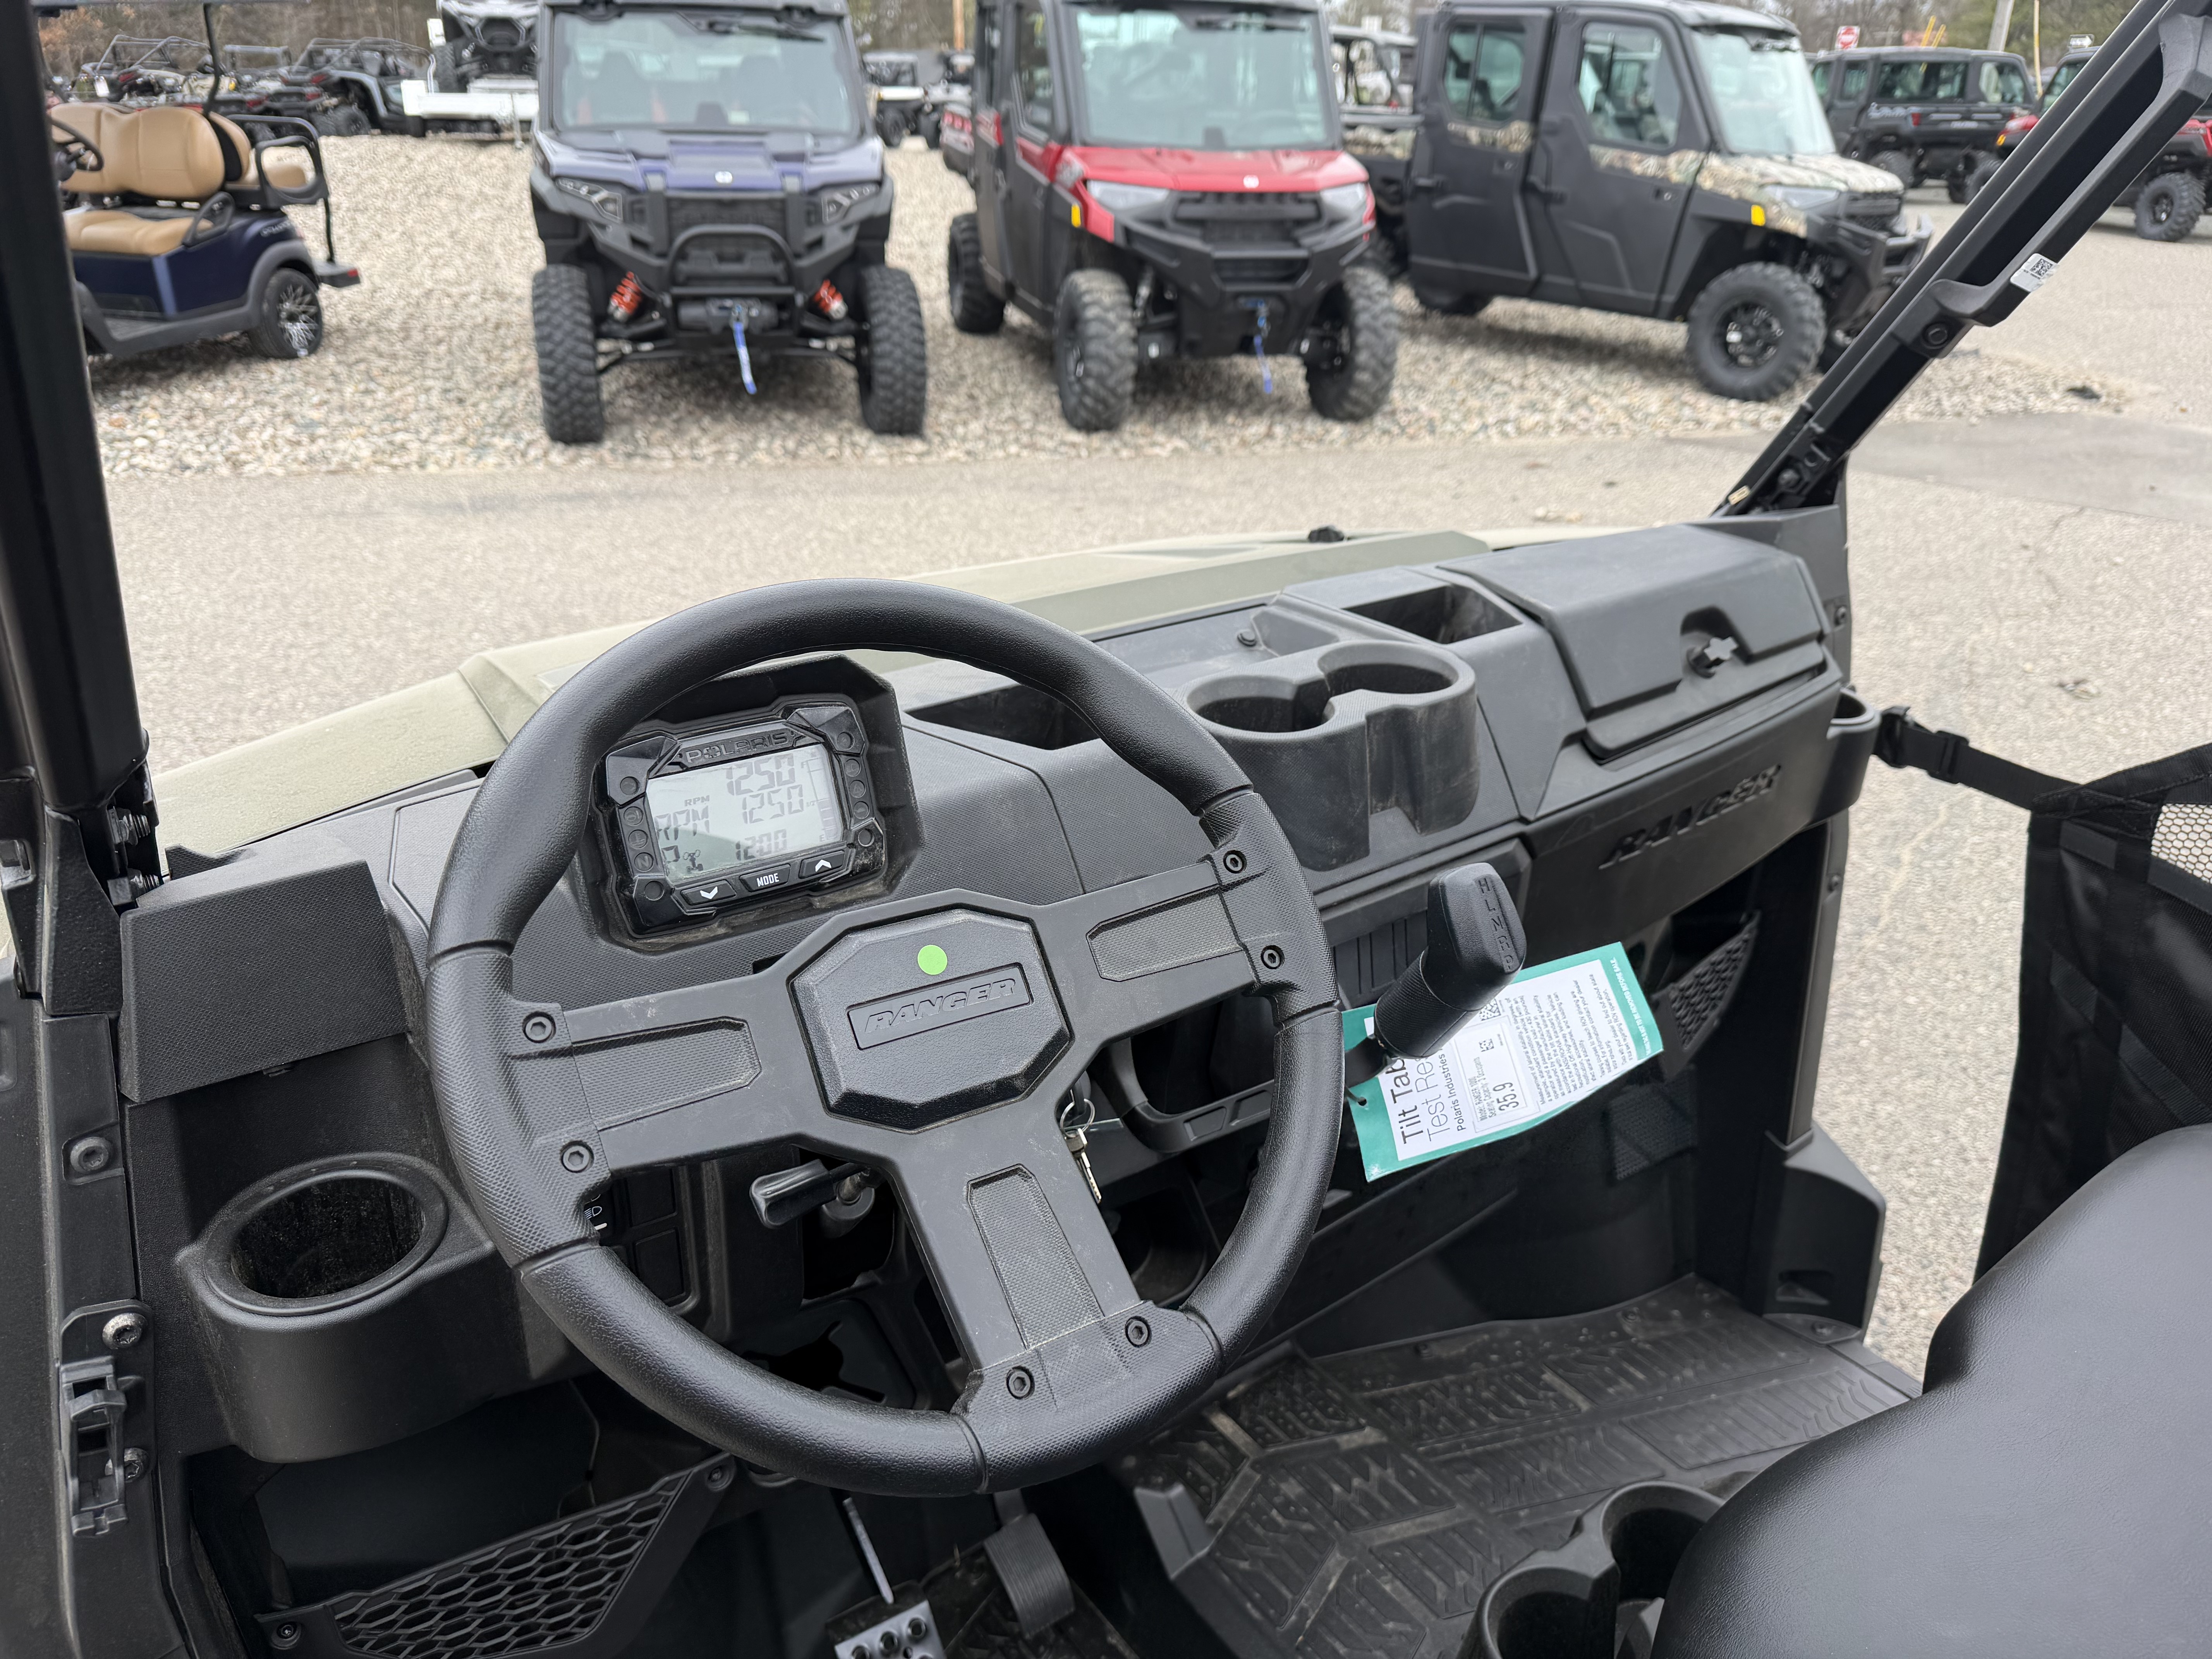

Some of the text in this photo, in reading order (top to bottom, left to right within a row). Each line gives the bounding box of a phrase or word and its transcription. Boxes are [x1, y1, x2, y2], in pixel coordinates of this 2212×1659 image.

[685, 732, 788, 763] POLARIS
[726, 754, 795, 796] 1250
[684, 795, 710, 807] RPM
[742, 784, 804, 824] 1250
[654, 805, 710, 841] RPM
[756, 873, 780, 887] MODE
[1478, 878, 1491, 894] H
[1485, 899, 1496, 912] L
[1491, 915, 1504, 932] N
[864, 978, 1015, 1033] RANGER
[1385, 1059, 1423, 1144] Tilt Tab
[1438, 1053, 1466, 1131] Polaris Industries
[1472, 1087, 1482, 1105] RANGER
[1493, 1082, 1519, 1111] 35.9
[1421, 1094, 1450, 1142] Test
